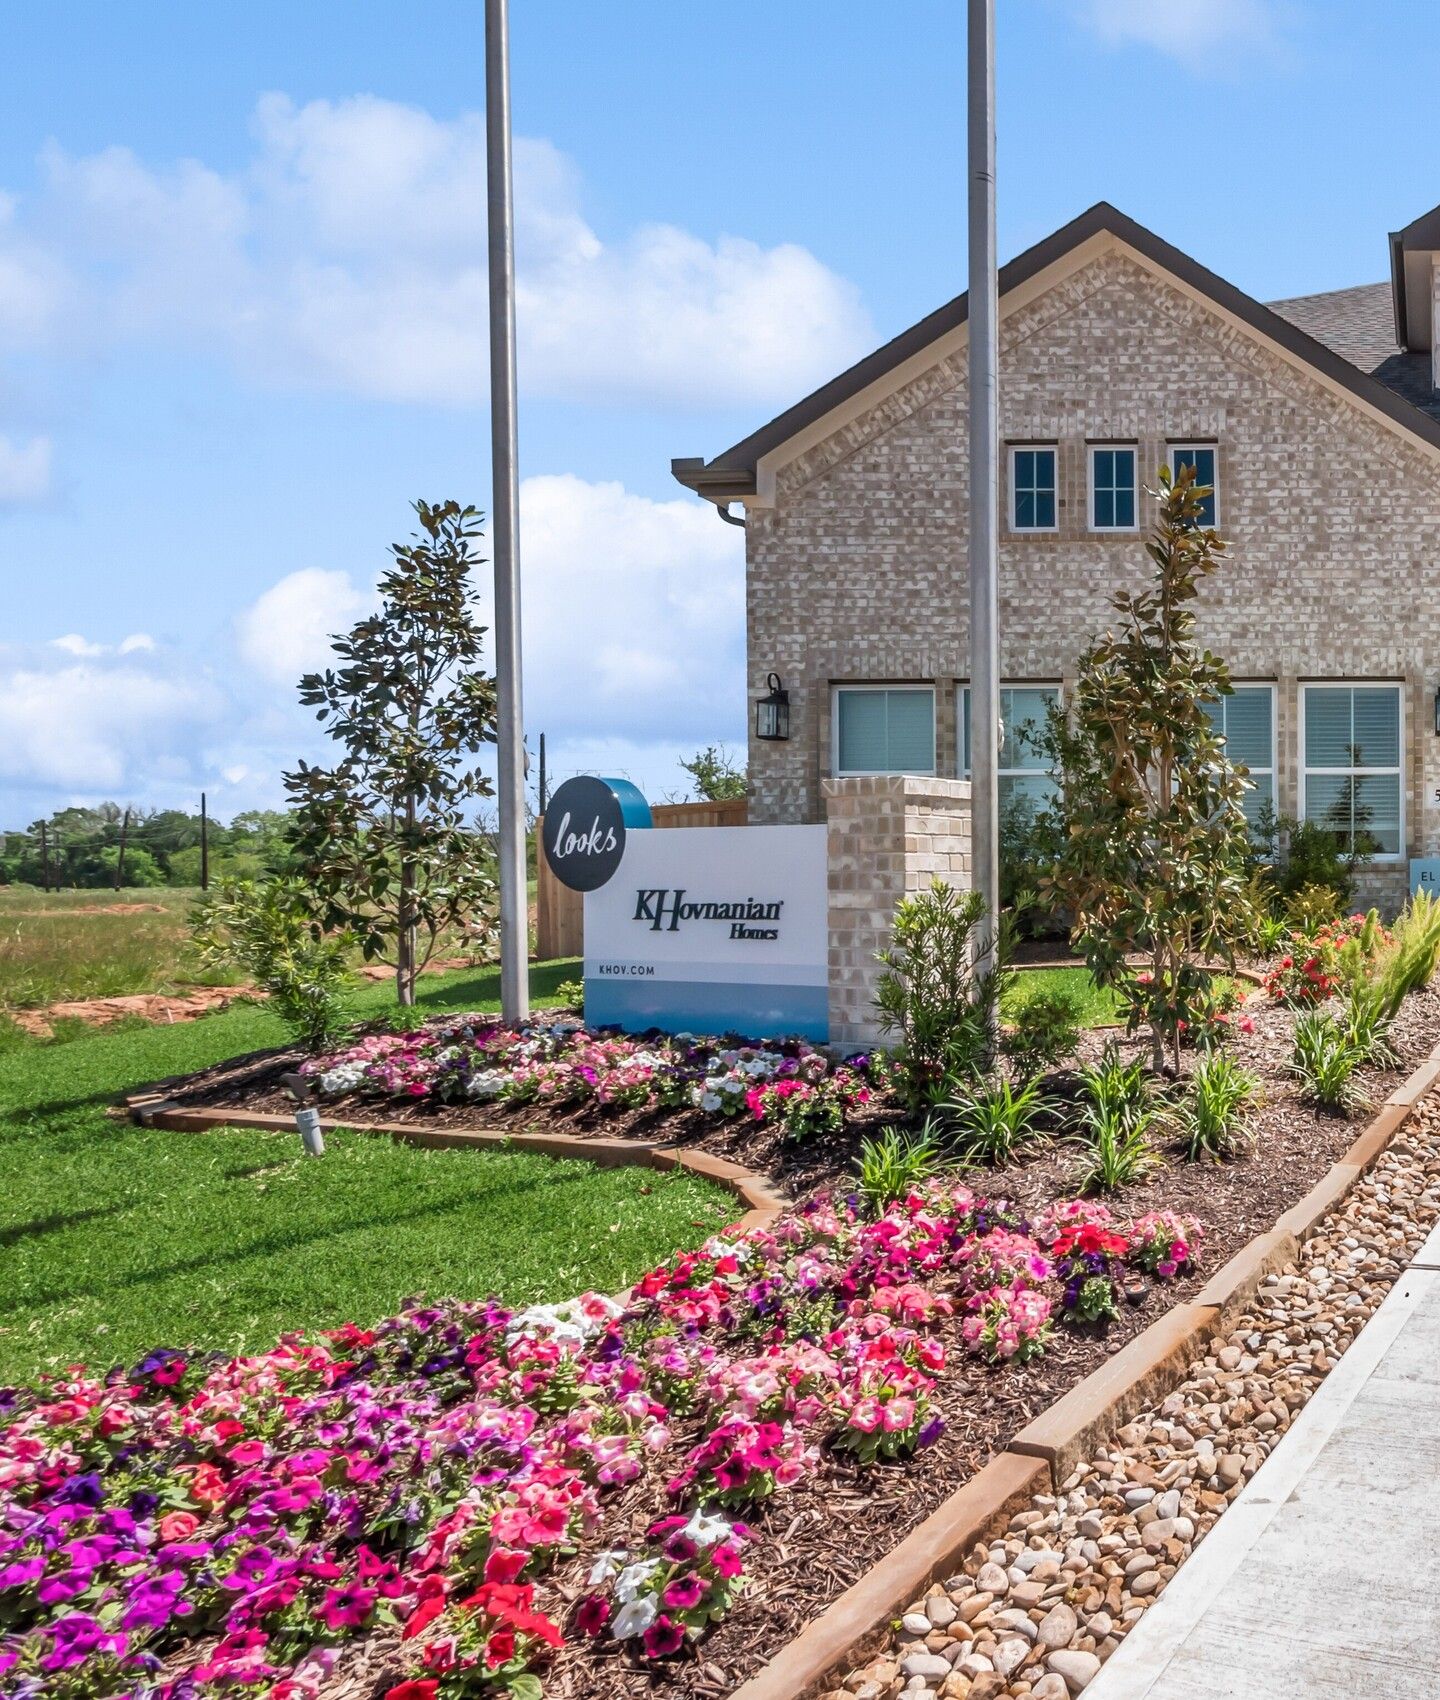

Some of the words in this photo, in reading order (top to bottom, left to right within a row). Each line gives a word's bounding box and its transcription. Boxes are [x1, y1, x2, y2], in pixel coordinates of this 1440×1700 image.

[553, 812, 617, 858] looks
[1421, 871, 1436, 882] EL
[729, 923, 779, 940] Homes
[599, 964, 655, 976] KHOV.COM
